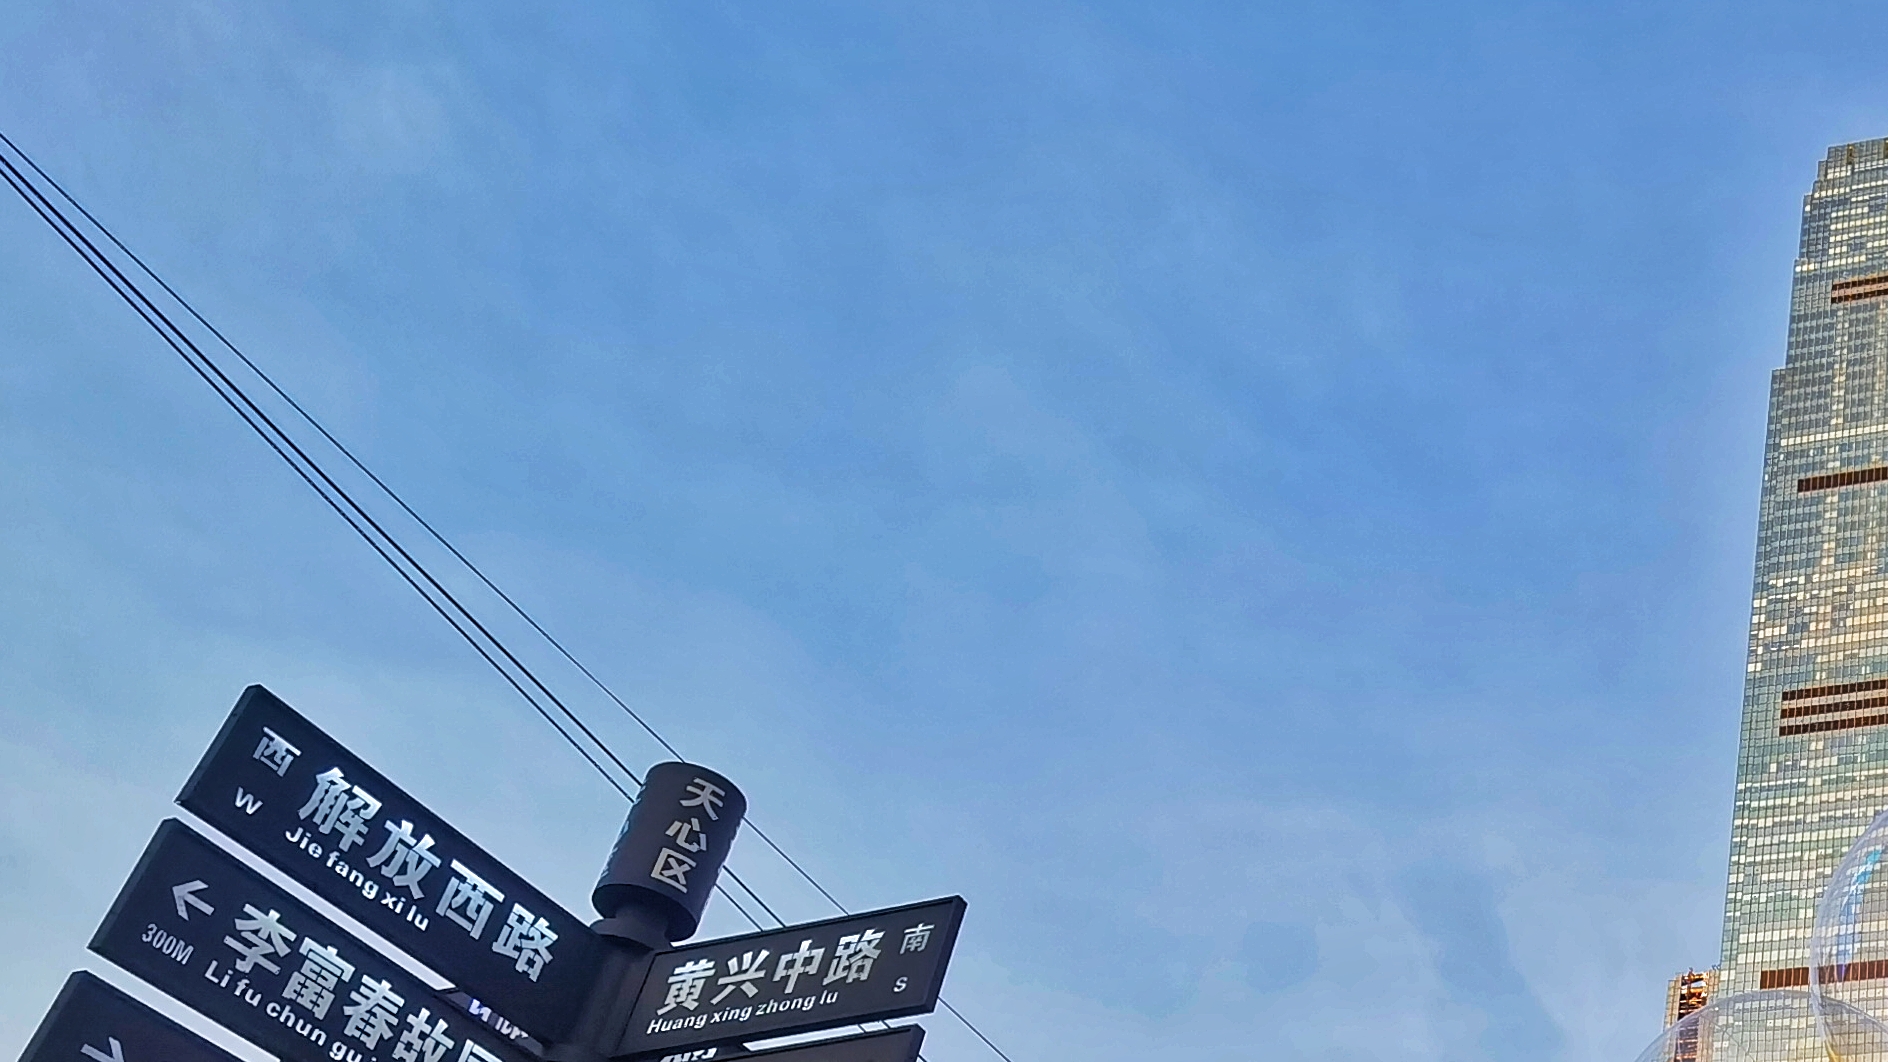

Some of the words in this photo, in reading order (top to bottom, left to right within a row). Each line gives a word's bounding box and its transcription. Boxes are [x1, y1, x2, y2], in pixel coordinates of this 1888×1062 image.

[252, 726, 302, 778] 西
[233, 786, 263, 816] W
[650, 776, 726, 894] 天心区
[285, 827, 323, 859] Jie
[325, 851, 379, 900] fang
[380, 892, 407, 915] xi
[406, 905, 430, 932] lu
[297, 766, 560, 984] 解放西路
[141, 922, 194, 965] 300M
[899, 922, 935, 955] 南
[656, 929, 886, 1016] 黄兴中路
[893, 976, 909, 993] S
[204, 960, 234, 989] Li
[234, 978, 263, 1007] fu
[266, 1001, 328, 1047] chun
[646, 1013, 707, 1035] Huang
[710, 1003, 752, 1024] xing
[755, 993, 816, 1016] zhong
[818, 989, 839, 1005] lu
